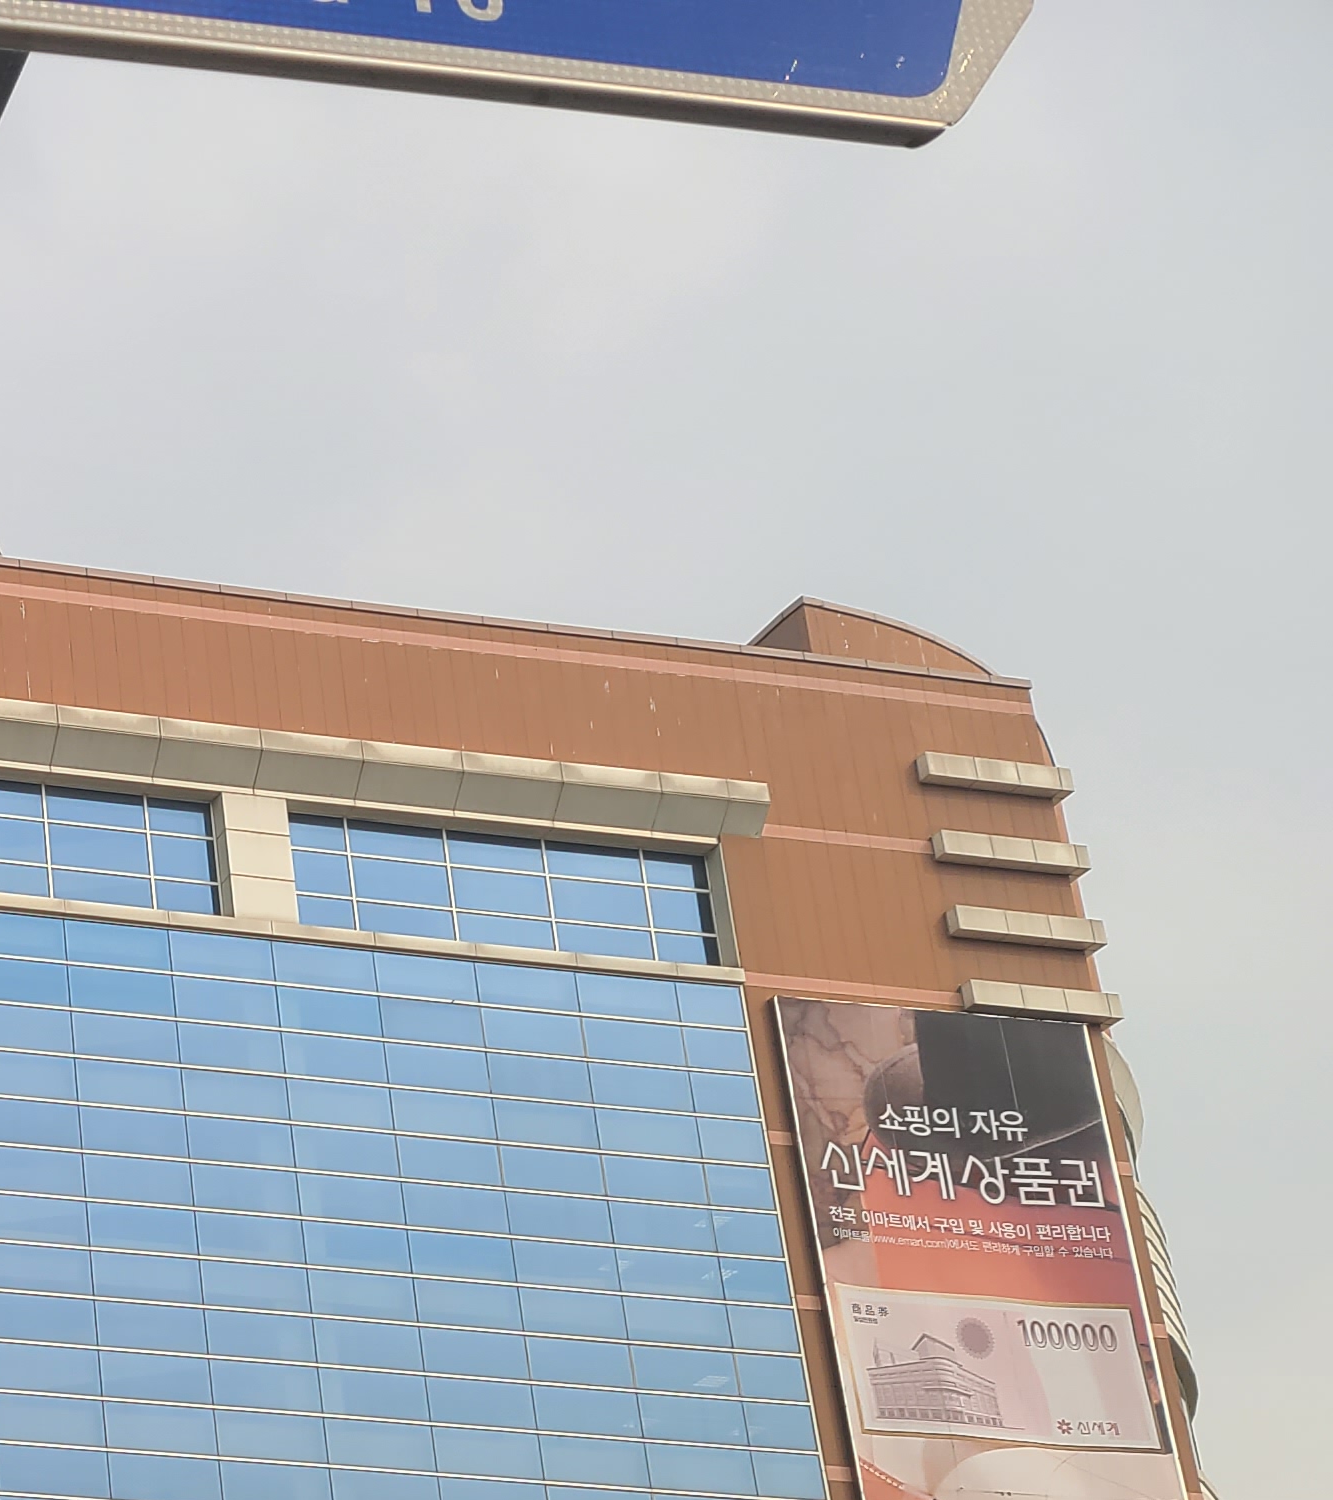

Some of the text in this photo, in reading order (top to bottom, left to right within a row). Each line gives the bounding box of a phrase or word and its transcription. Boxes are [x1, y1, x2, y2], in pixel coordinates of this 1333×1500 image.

[878, 1103, 1029, 1142] 쇼핑의 자유
[820, 1140, 1105, 1208] 신세계 상품권
[829, 1206, 1111, 1242] 전국 이마트에서 구입 및 사용이 편리합니다
[982, 1241, 1021, 1256] 편리하게
[1058, 1246, 1070, 1257] 수
[1072, 1246, 1113, 1259] 있습니다
[1017, 1319, 1118, 1352] 100000
[1077, 1421, 1121, 1436] 신세계
